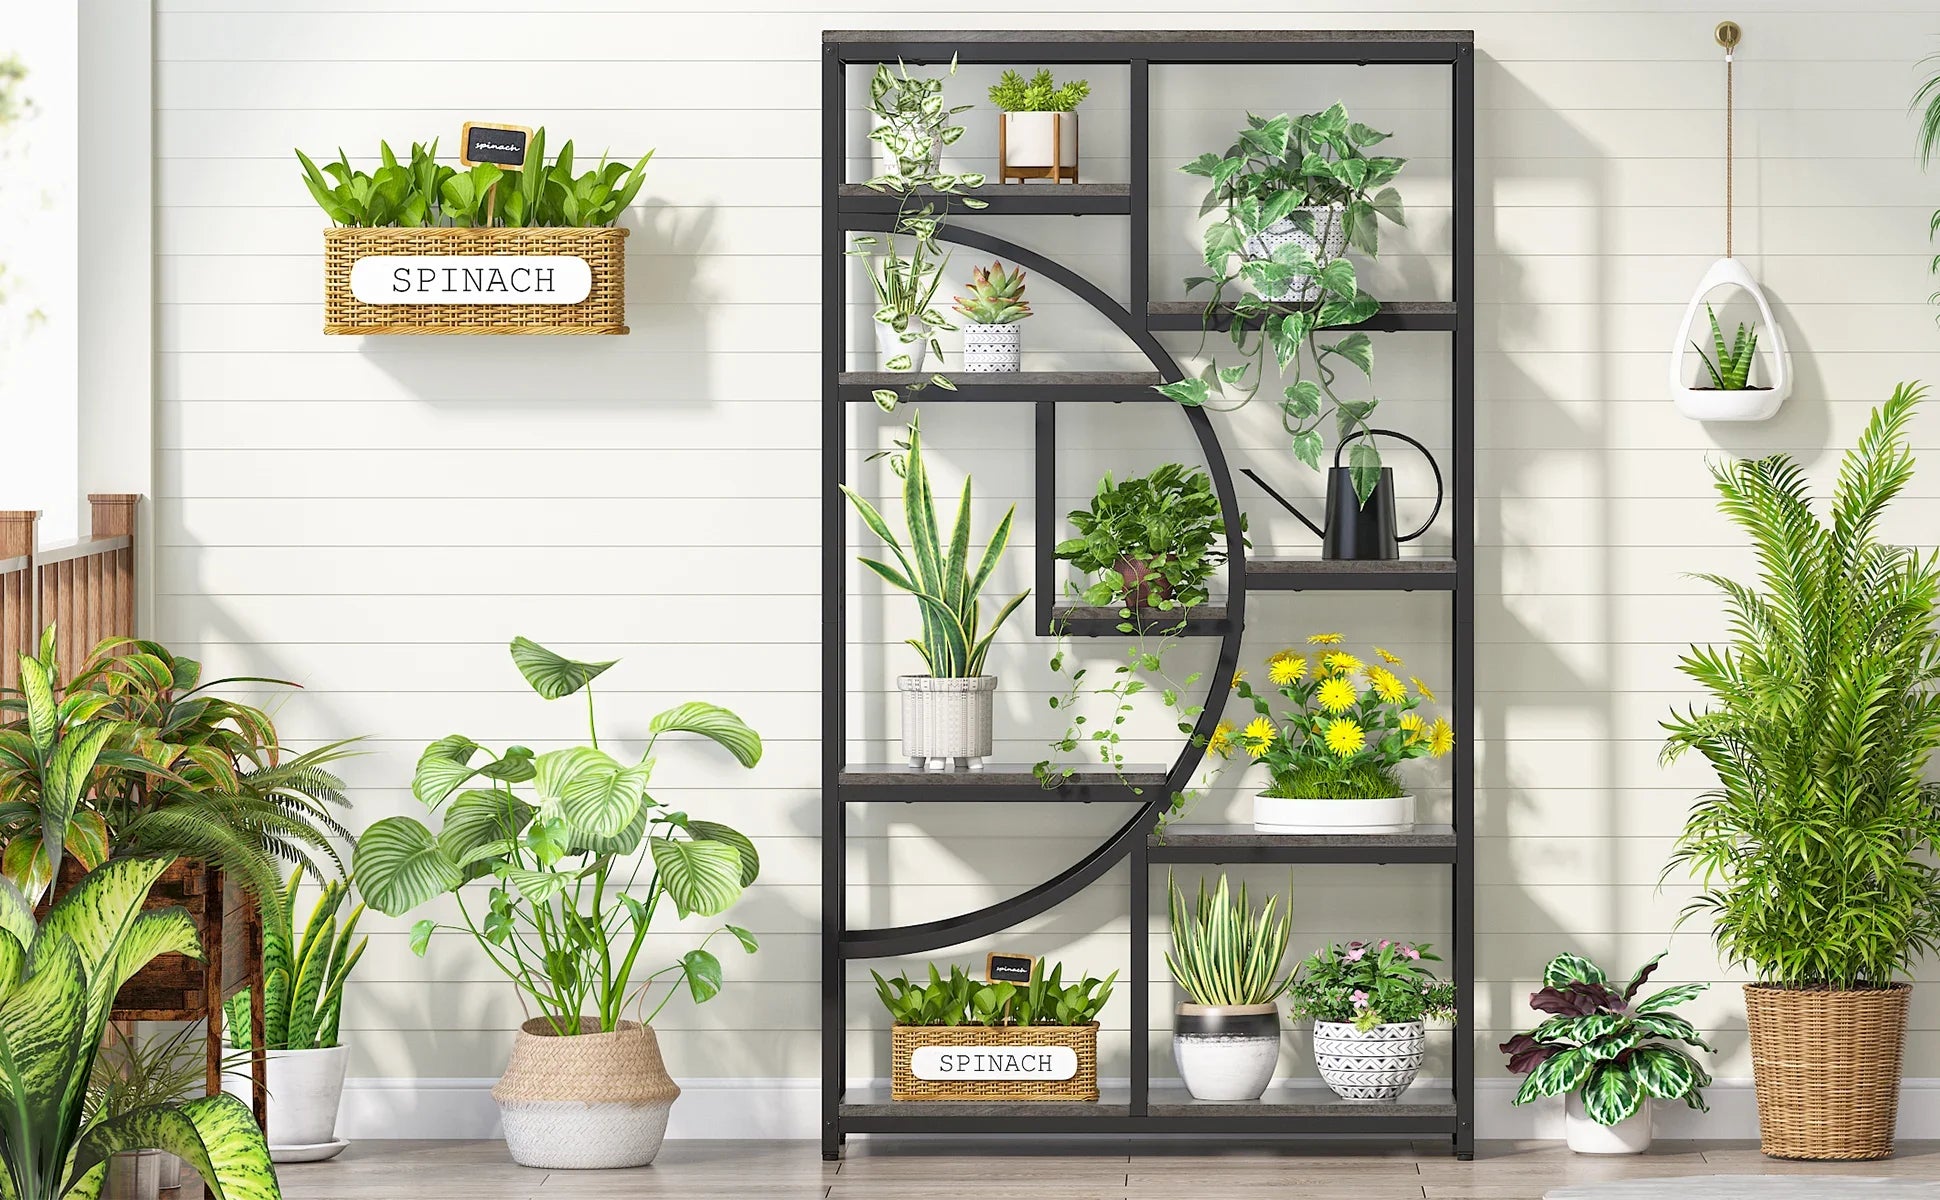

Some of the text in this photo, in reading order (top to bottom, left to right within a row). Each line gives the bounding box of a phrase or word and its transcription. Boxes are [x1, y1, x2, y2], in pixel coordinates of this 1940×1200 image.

[474, 141, 520, 152] spinach
[393, 268, 555, 292] SPINACH
[940, 1055, 1052, 1072] SPINACH
